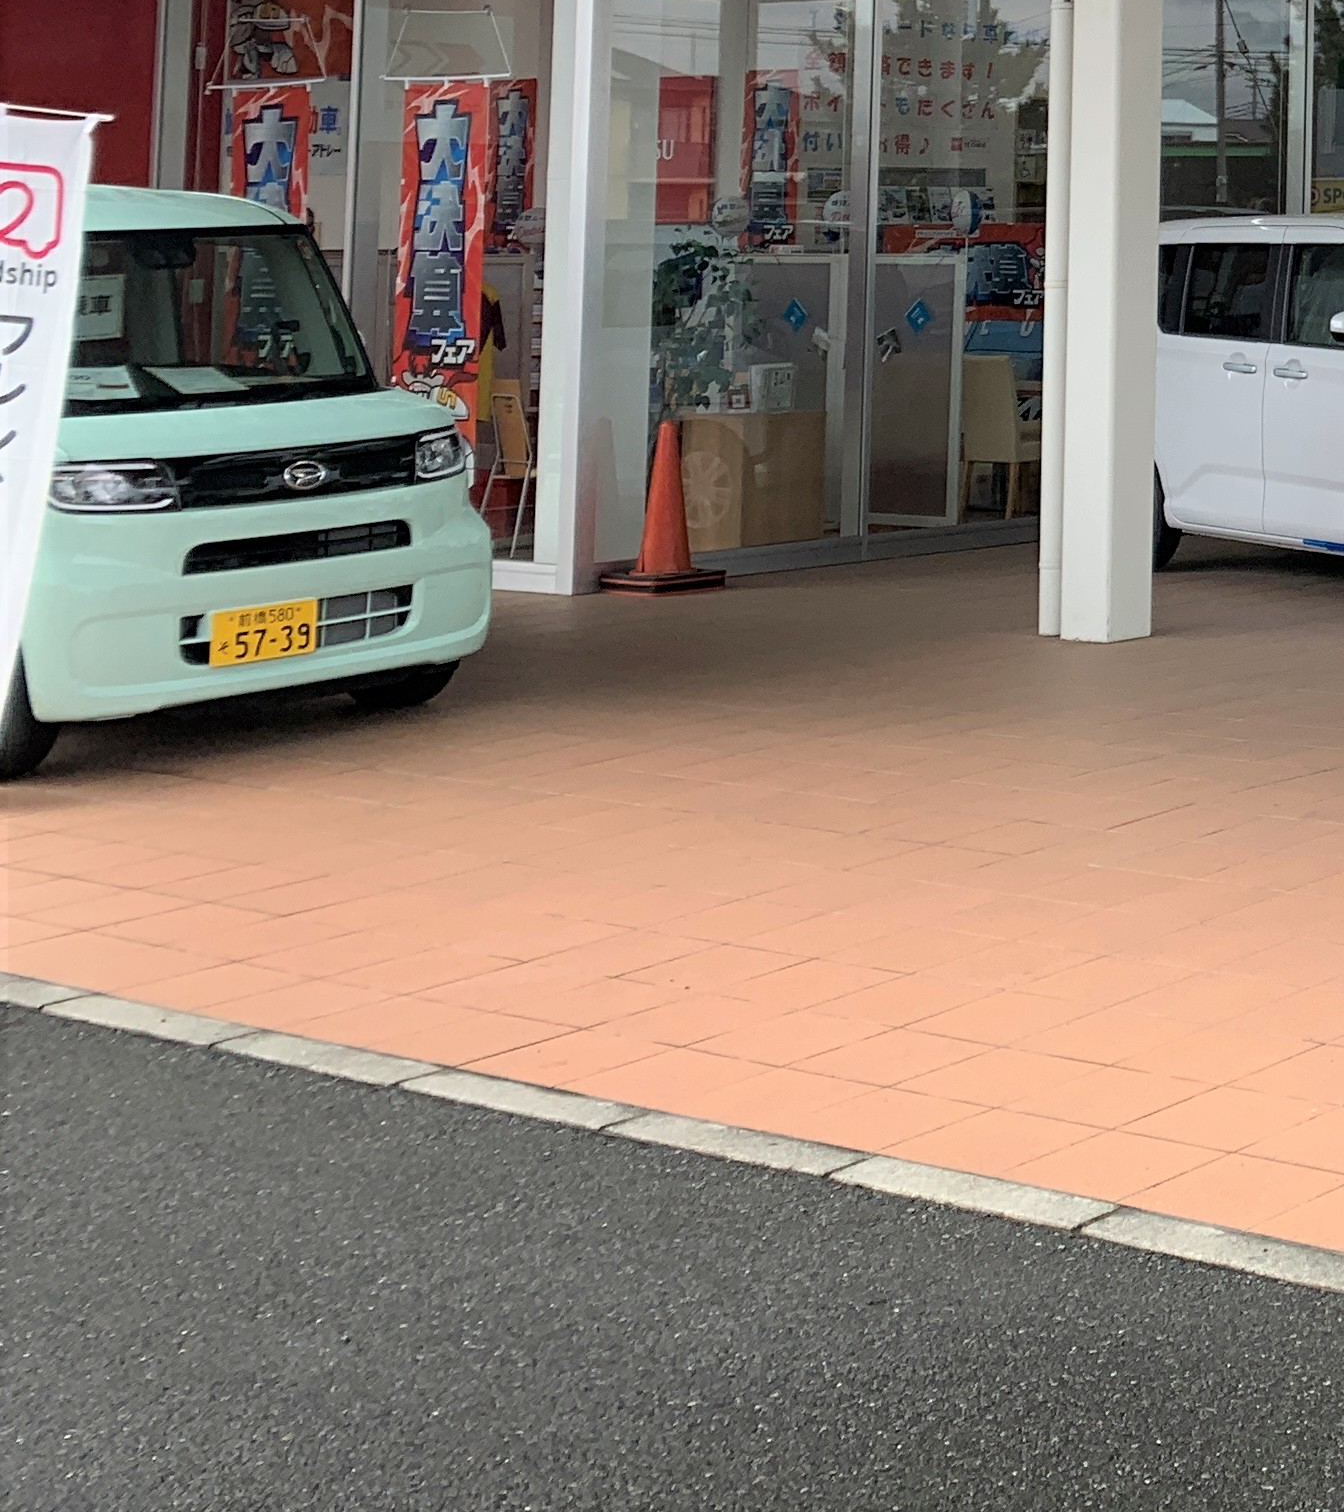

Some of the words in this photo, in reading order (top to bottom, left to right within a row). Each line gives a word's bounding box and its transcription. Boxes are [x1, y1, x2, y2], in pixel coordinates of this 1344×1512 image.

[409, 99, 471, 338] 大決算
[431, 339, 475, 365] フェア
[235, 623, 310, 659] 57-39
